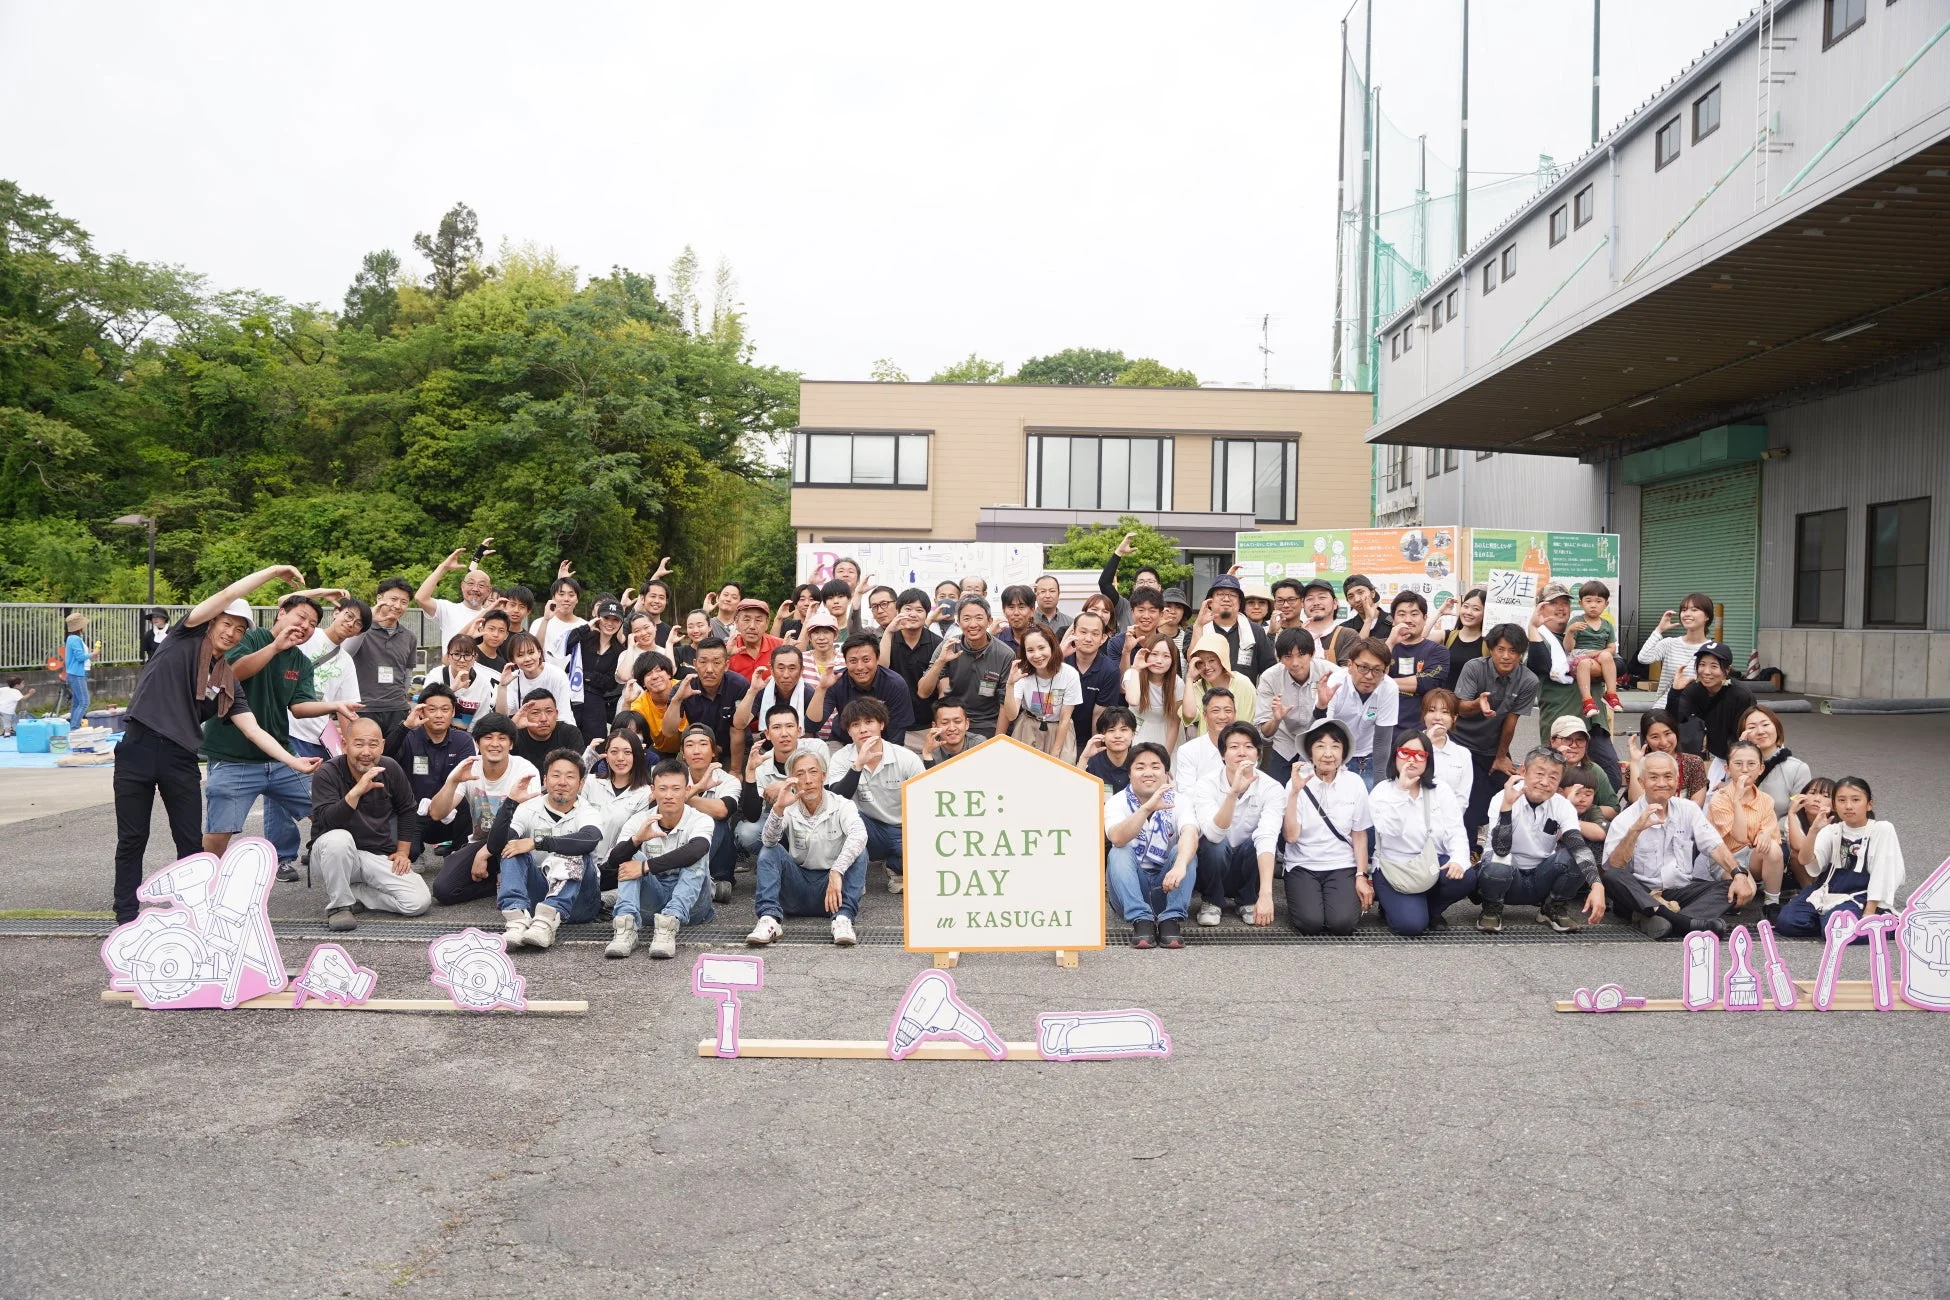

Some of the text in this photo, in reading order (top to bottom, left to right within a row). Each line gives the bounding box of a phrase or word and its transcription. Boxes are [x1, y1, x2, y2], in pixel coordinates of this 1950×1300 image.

[935, 790, 1004, 817] RE:
[935, 829, 1071, 858] CRAFT
[936, 870, 1010, 897] DAY
[936, 910, 1073, 929] in KASUGAI
